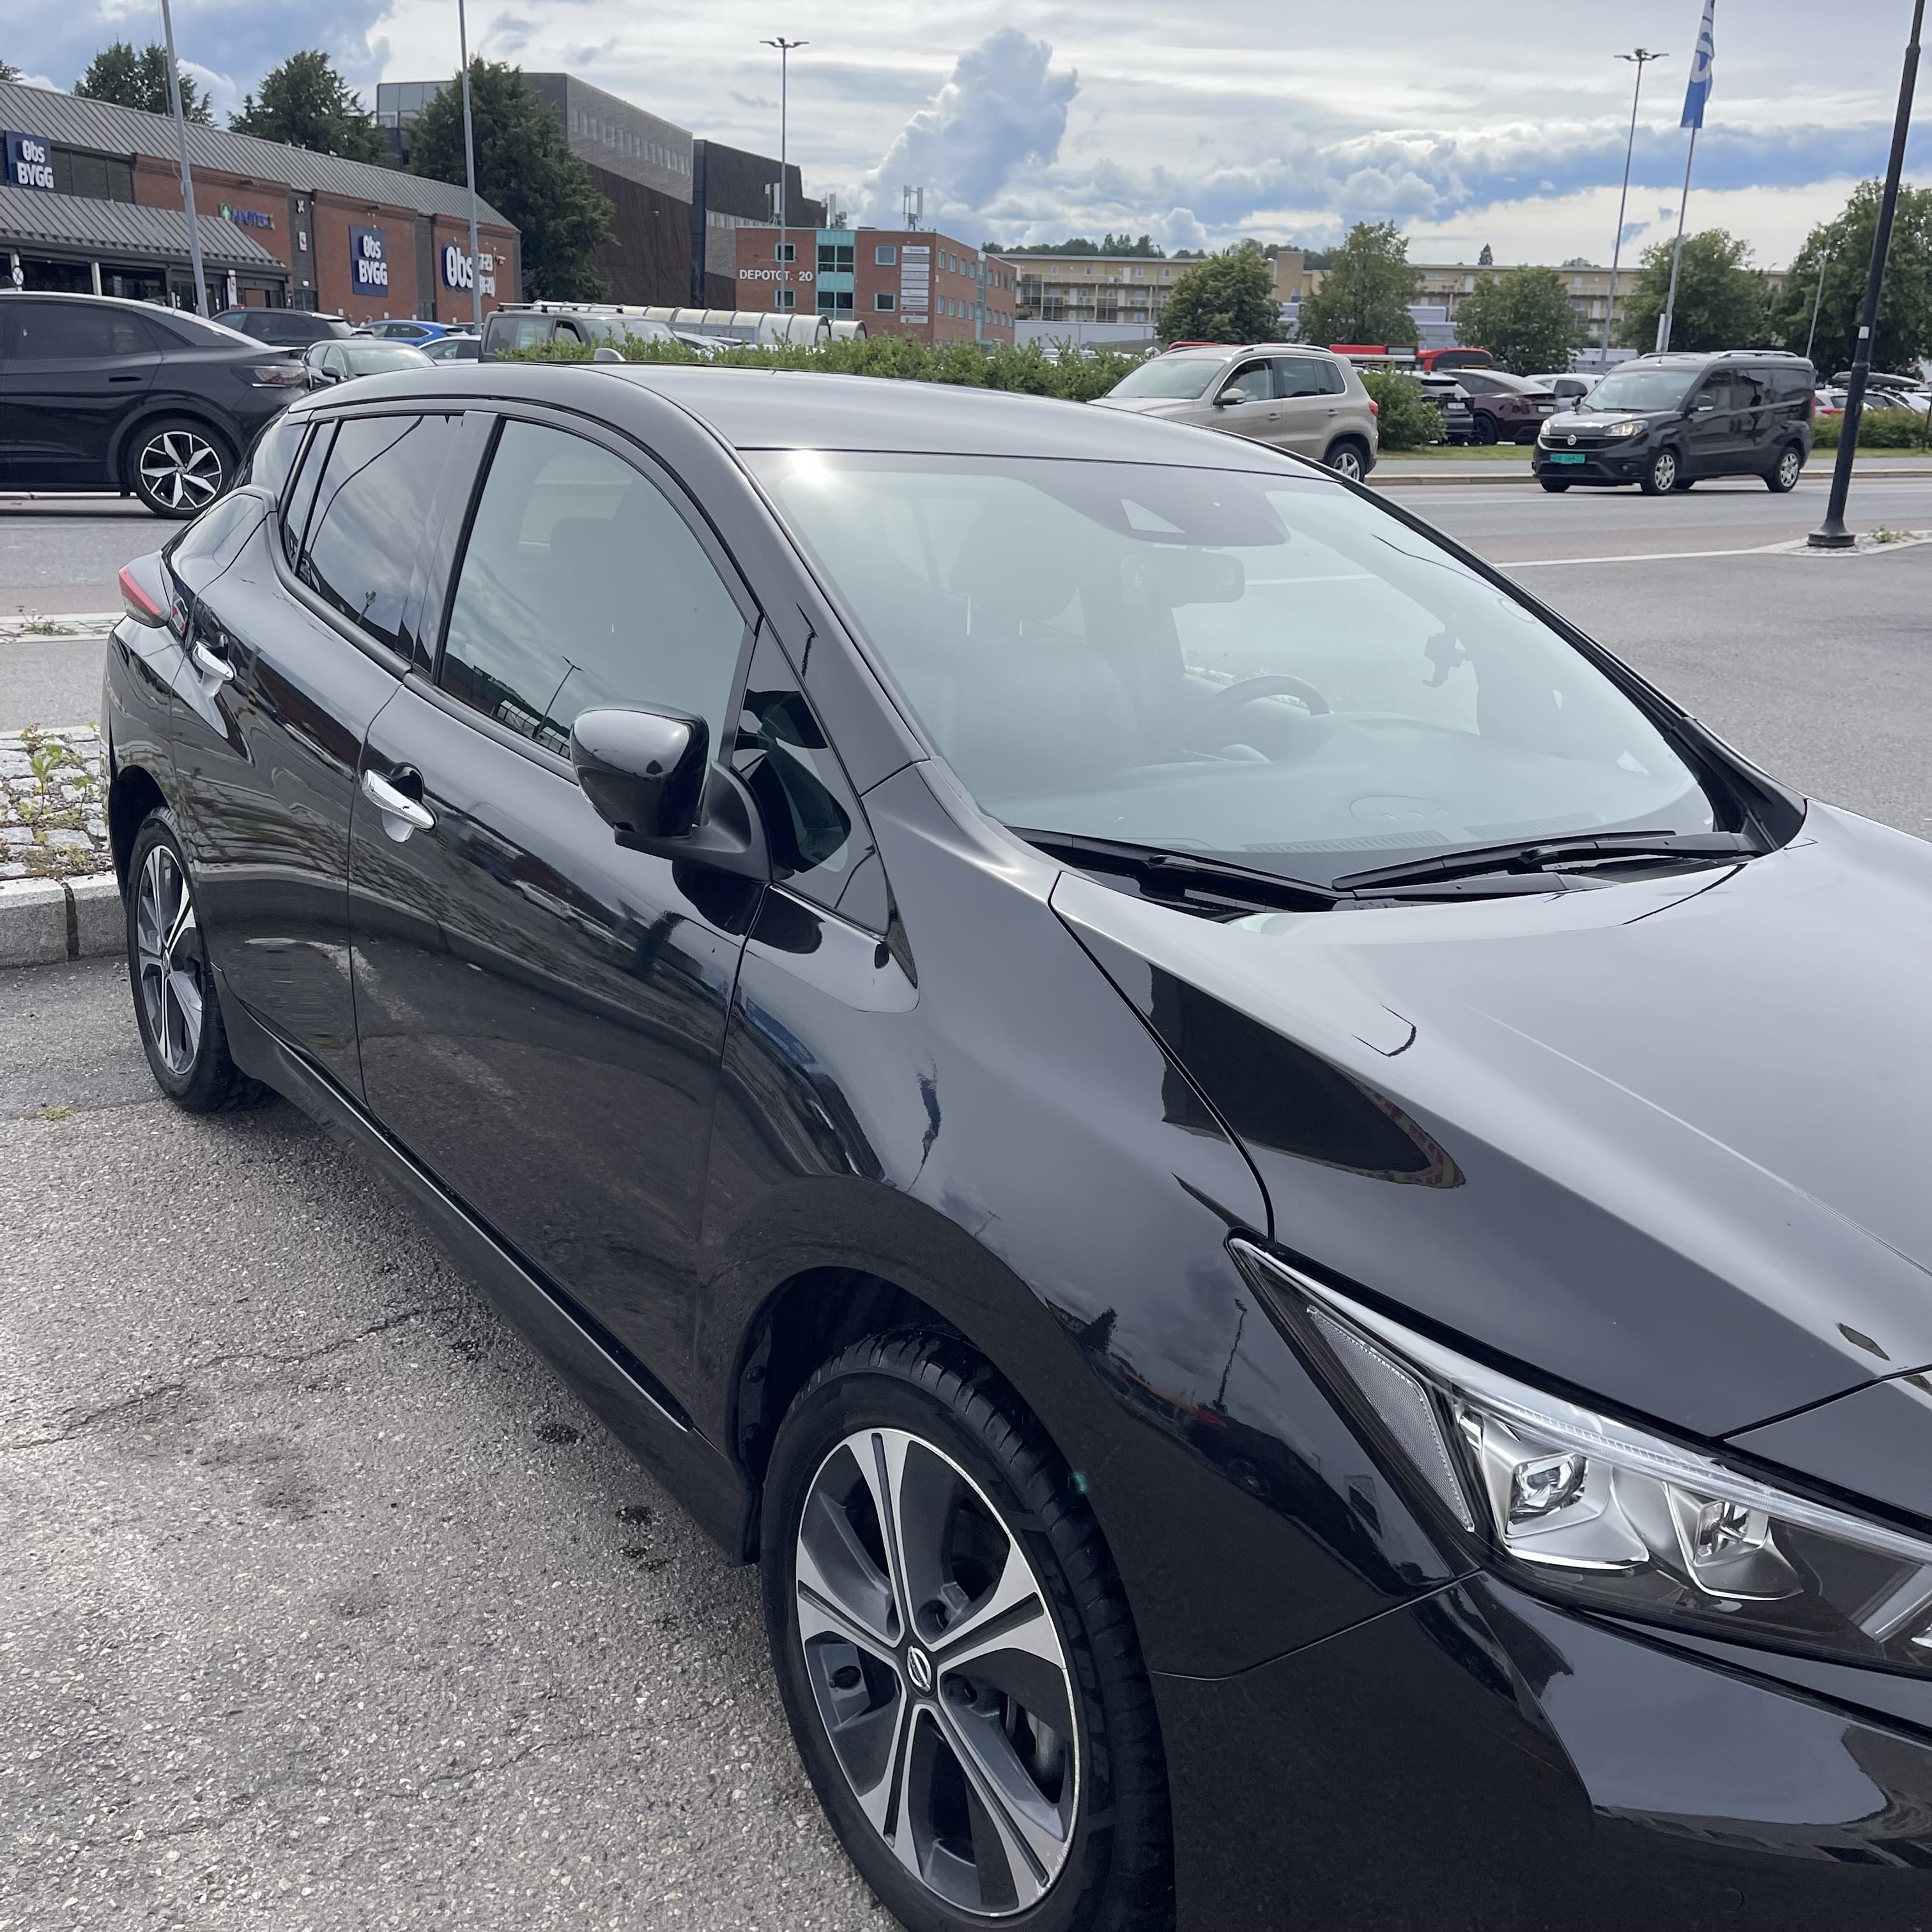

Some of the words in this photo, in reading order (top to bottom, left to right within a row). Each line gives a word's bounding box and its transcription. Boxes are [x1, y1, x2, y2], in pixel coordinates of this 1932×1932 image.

[22, 140, 45, 163] Obs
[17, 162, 54, 188] BYGG
[363, 235, 381, 259] Obs
[358, 259, 388, 286] BYGG
[446, 246, 473, 288] Obs
[799, 271, 813, 282] 20
